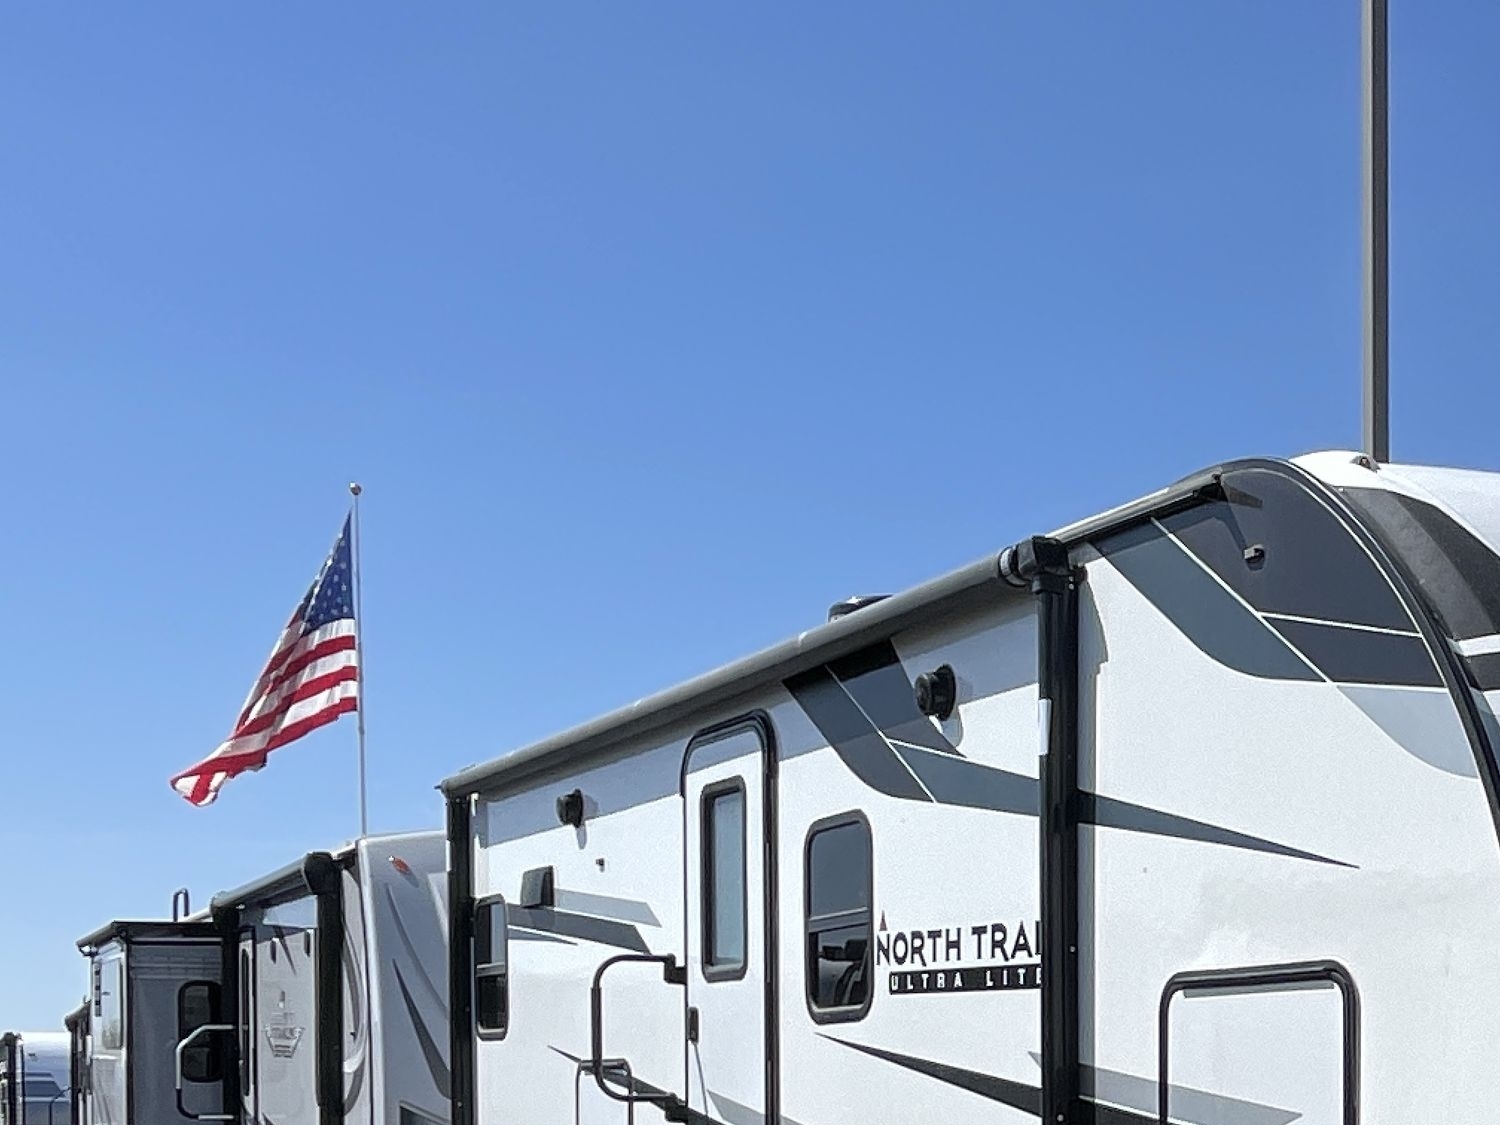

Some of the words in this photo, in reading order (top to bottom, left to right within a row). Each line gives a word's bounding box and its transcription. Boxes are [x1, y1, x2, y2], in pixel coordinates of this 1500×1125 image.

[876, 927, 962, 967] NORTH
[971, 920, 1042, 962] TRAI
[891, 970, 963, 991] ULTRA
